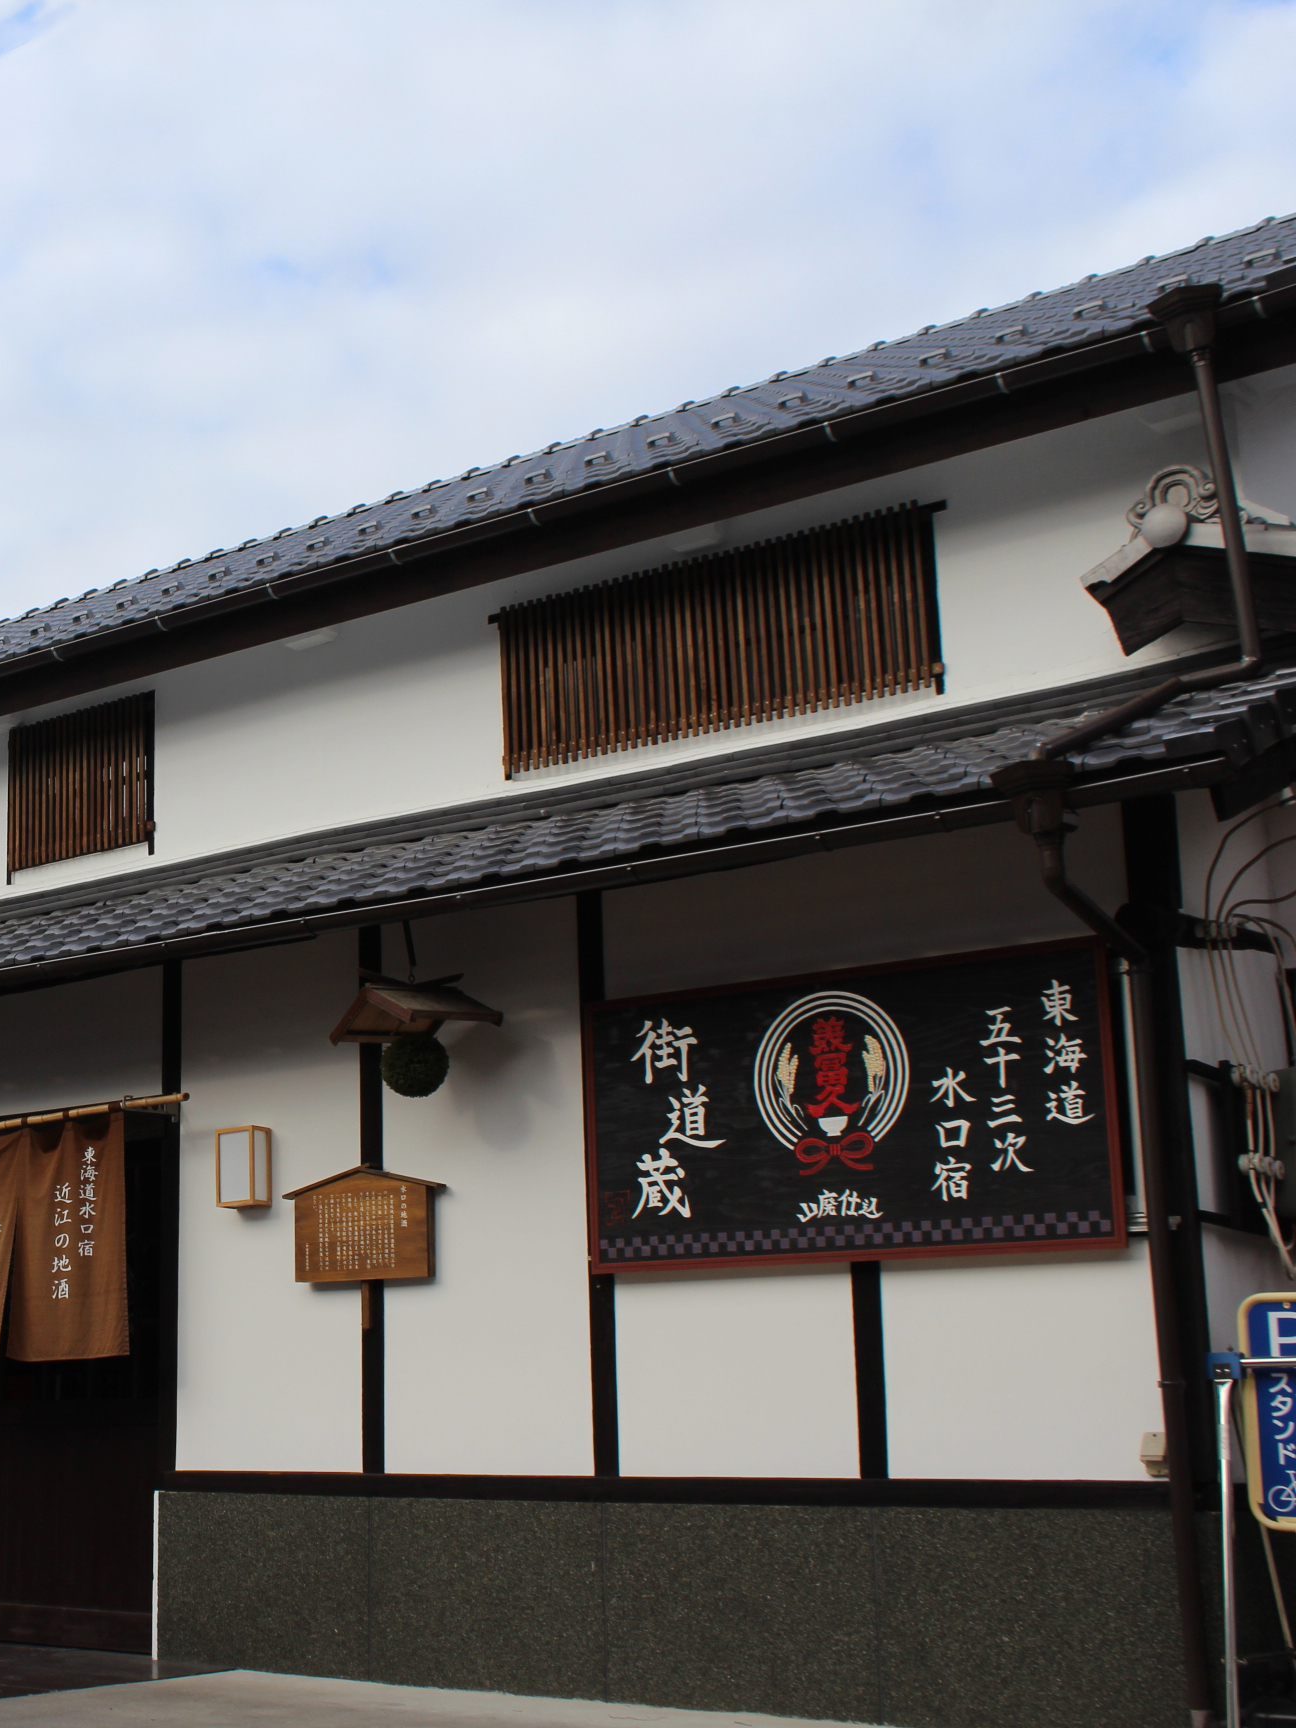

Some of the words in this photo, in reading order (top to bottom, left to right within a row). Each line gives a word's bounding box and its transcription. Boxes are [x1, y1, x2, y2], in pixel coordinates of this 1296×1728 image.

[630, 1017, 727, 1219] 街道蔵
[978, 1006, 1035, 1173] 五十三次
[1040, 979, 1096, 1125] 東海道
[77, 1145, 99, 1258] 東海道水口宿
[930, 1067, 977, 1202] 水口宿
[51, 1183, 73, 1300] 近江の地酒
[1268, 1373, 1296, 1466] スタンド
